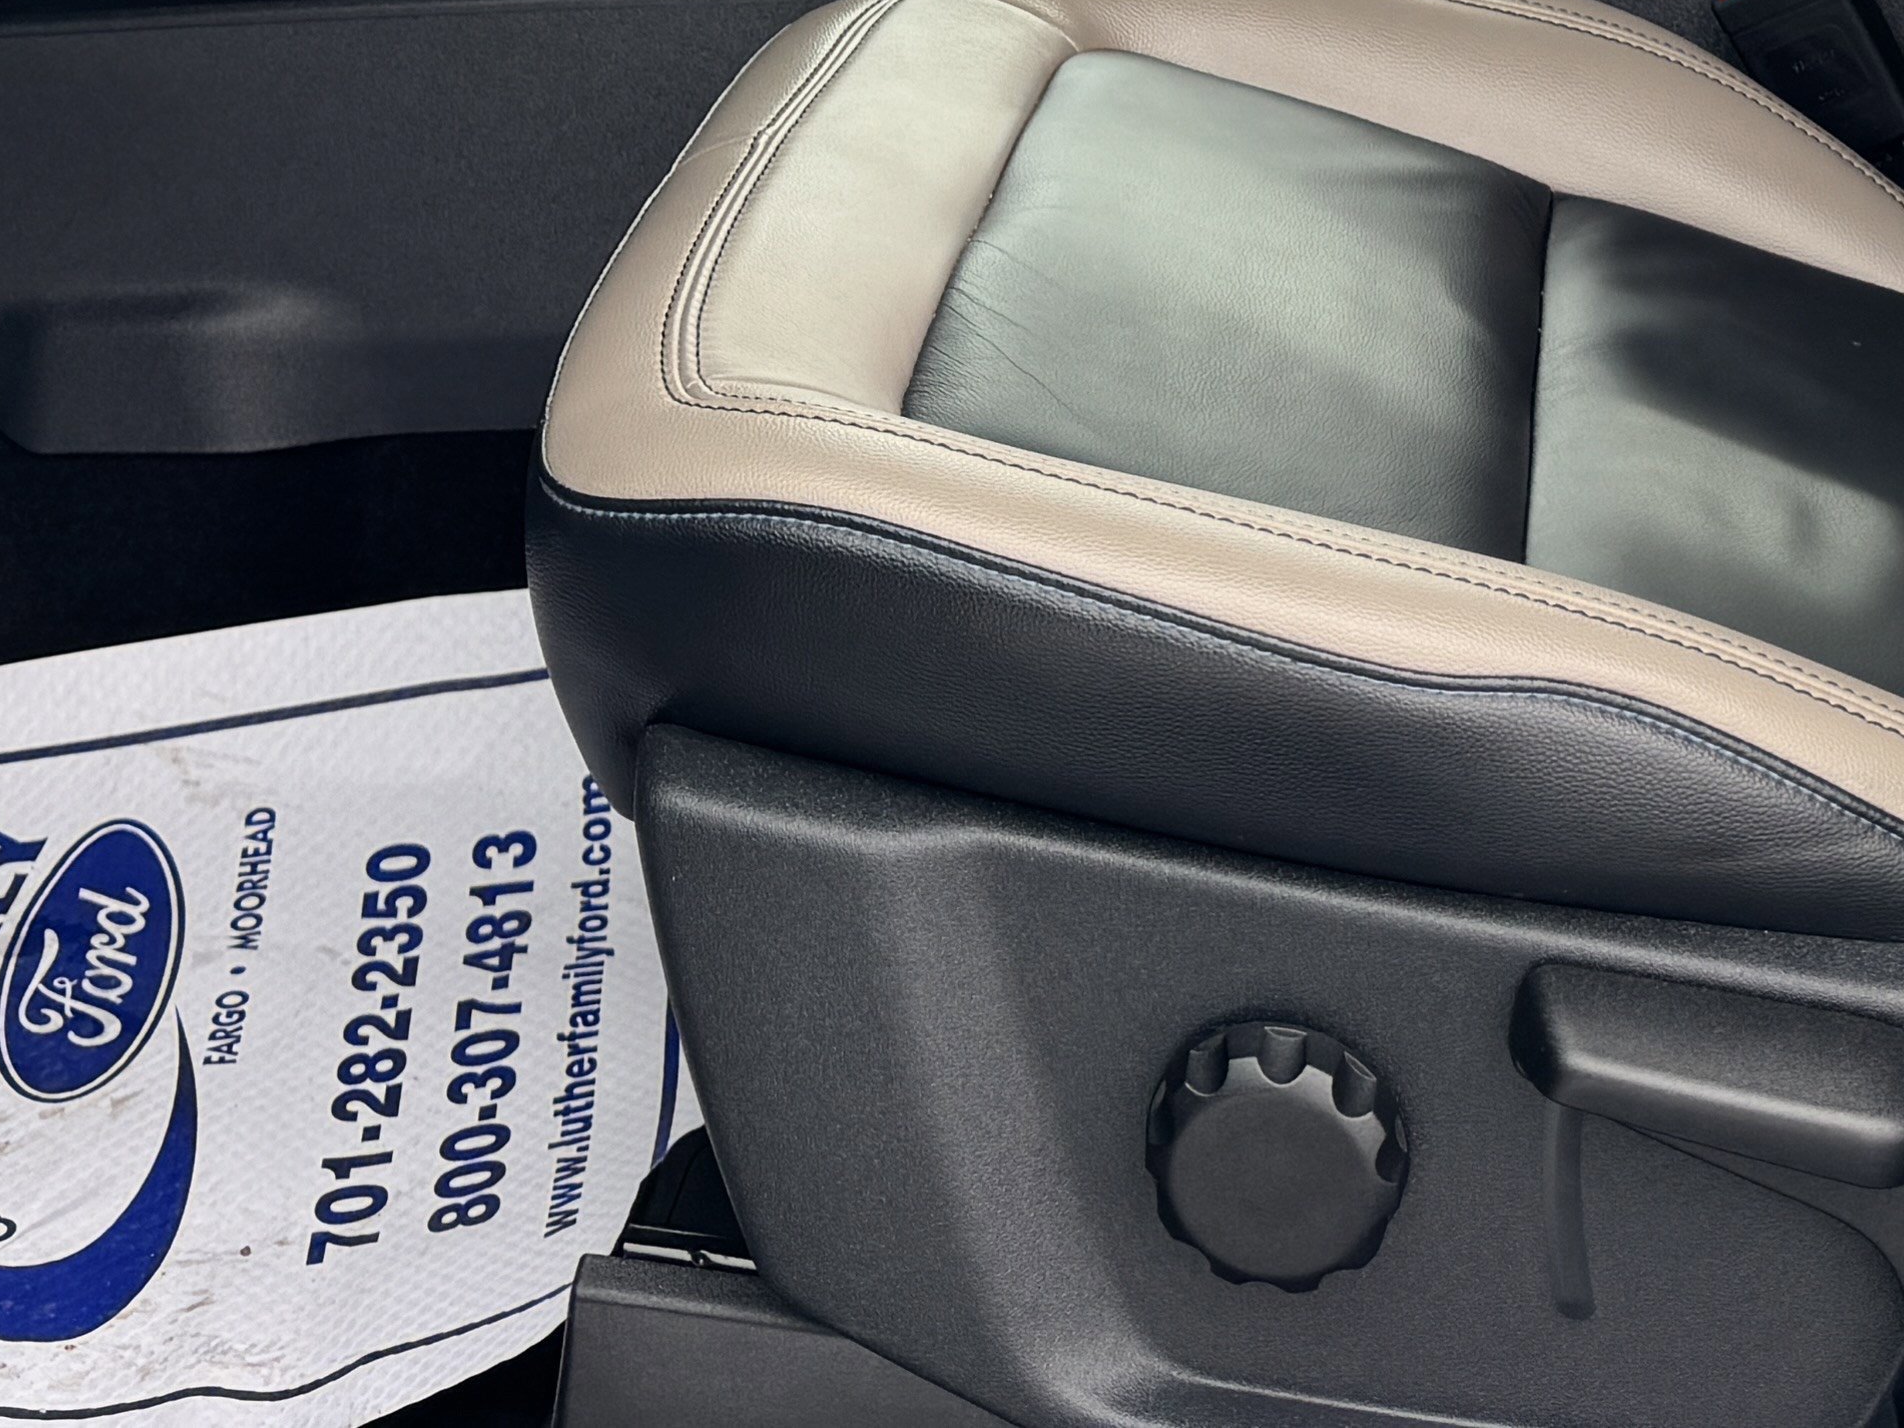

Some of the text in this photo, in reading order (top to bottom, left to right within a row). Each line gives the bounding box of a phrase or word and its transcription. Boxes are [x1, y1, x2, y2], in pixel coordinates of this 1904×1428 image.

[16, 887, 152, 1052] Ford
[203, 805, 279, 1067] FARGO MOORHEAD
[306, 841, 432, 1267] 701-282-2350
[428, 827, 539, 1235] 800-307-4813
[543, 774, 615, 1239] www.lutherfamilyford.com
